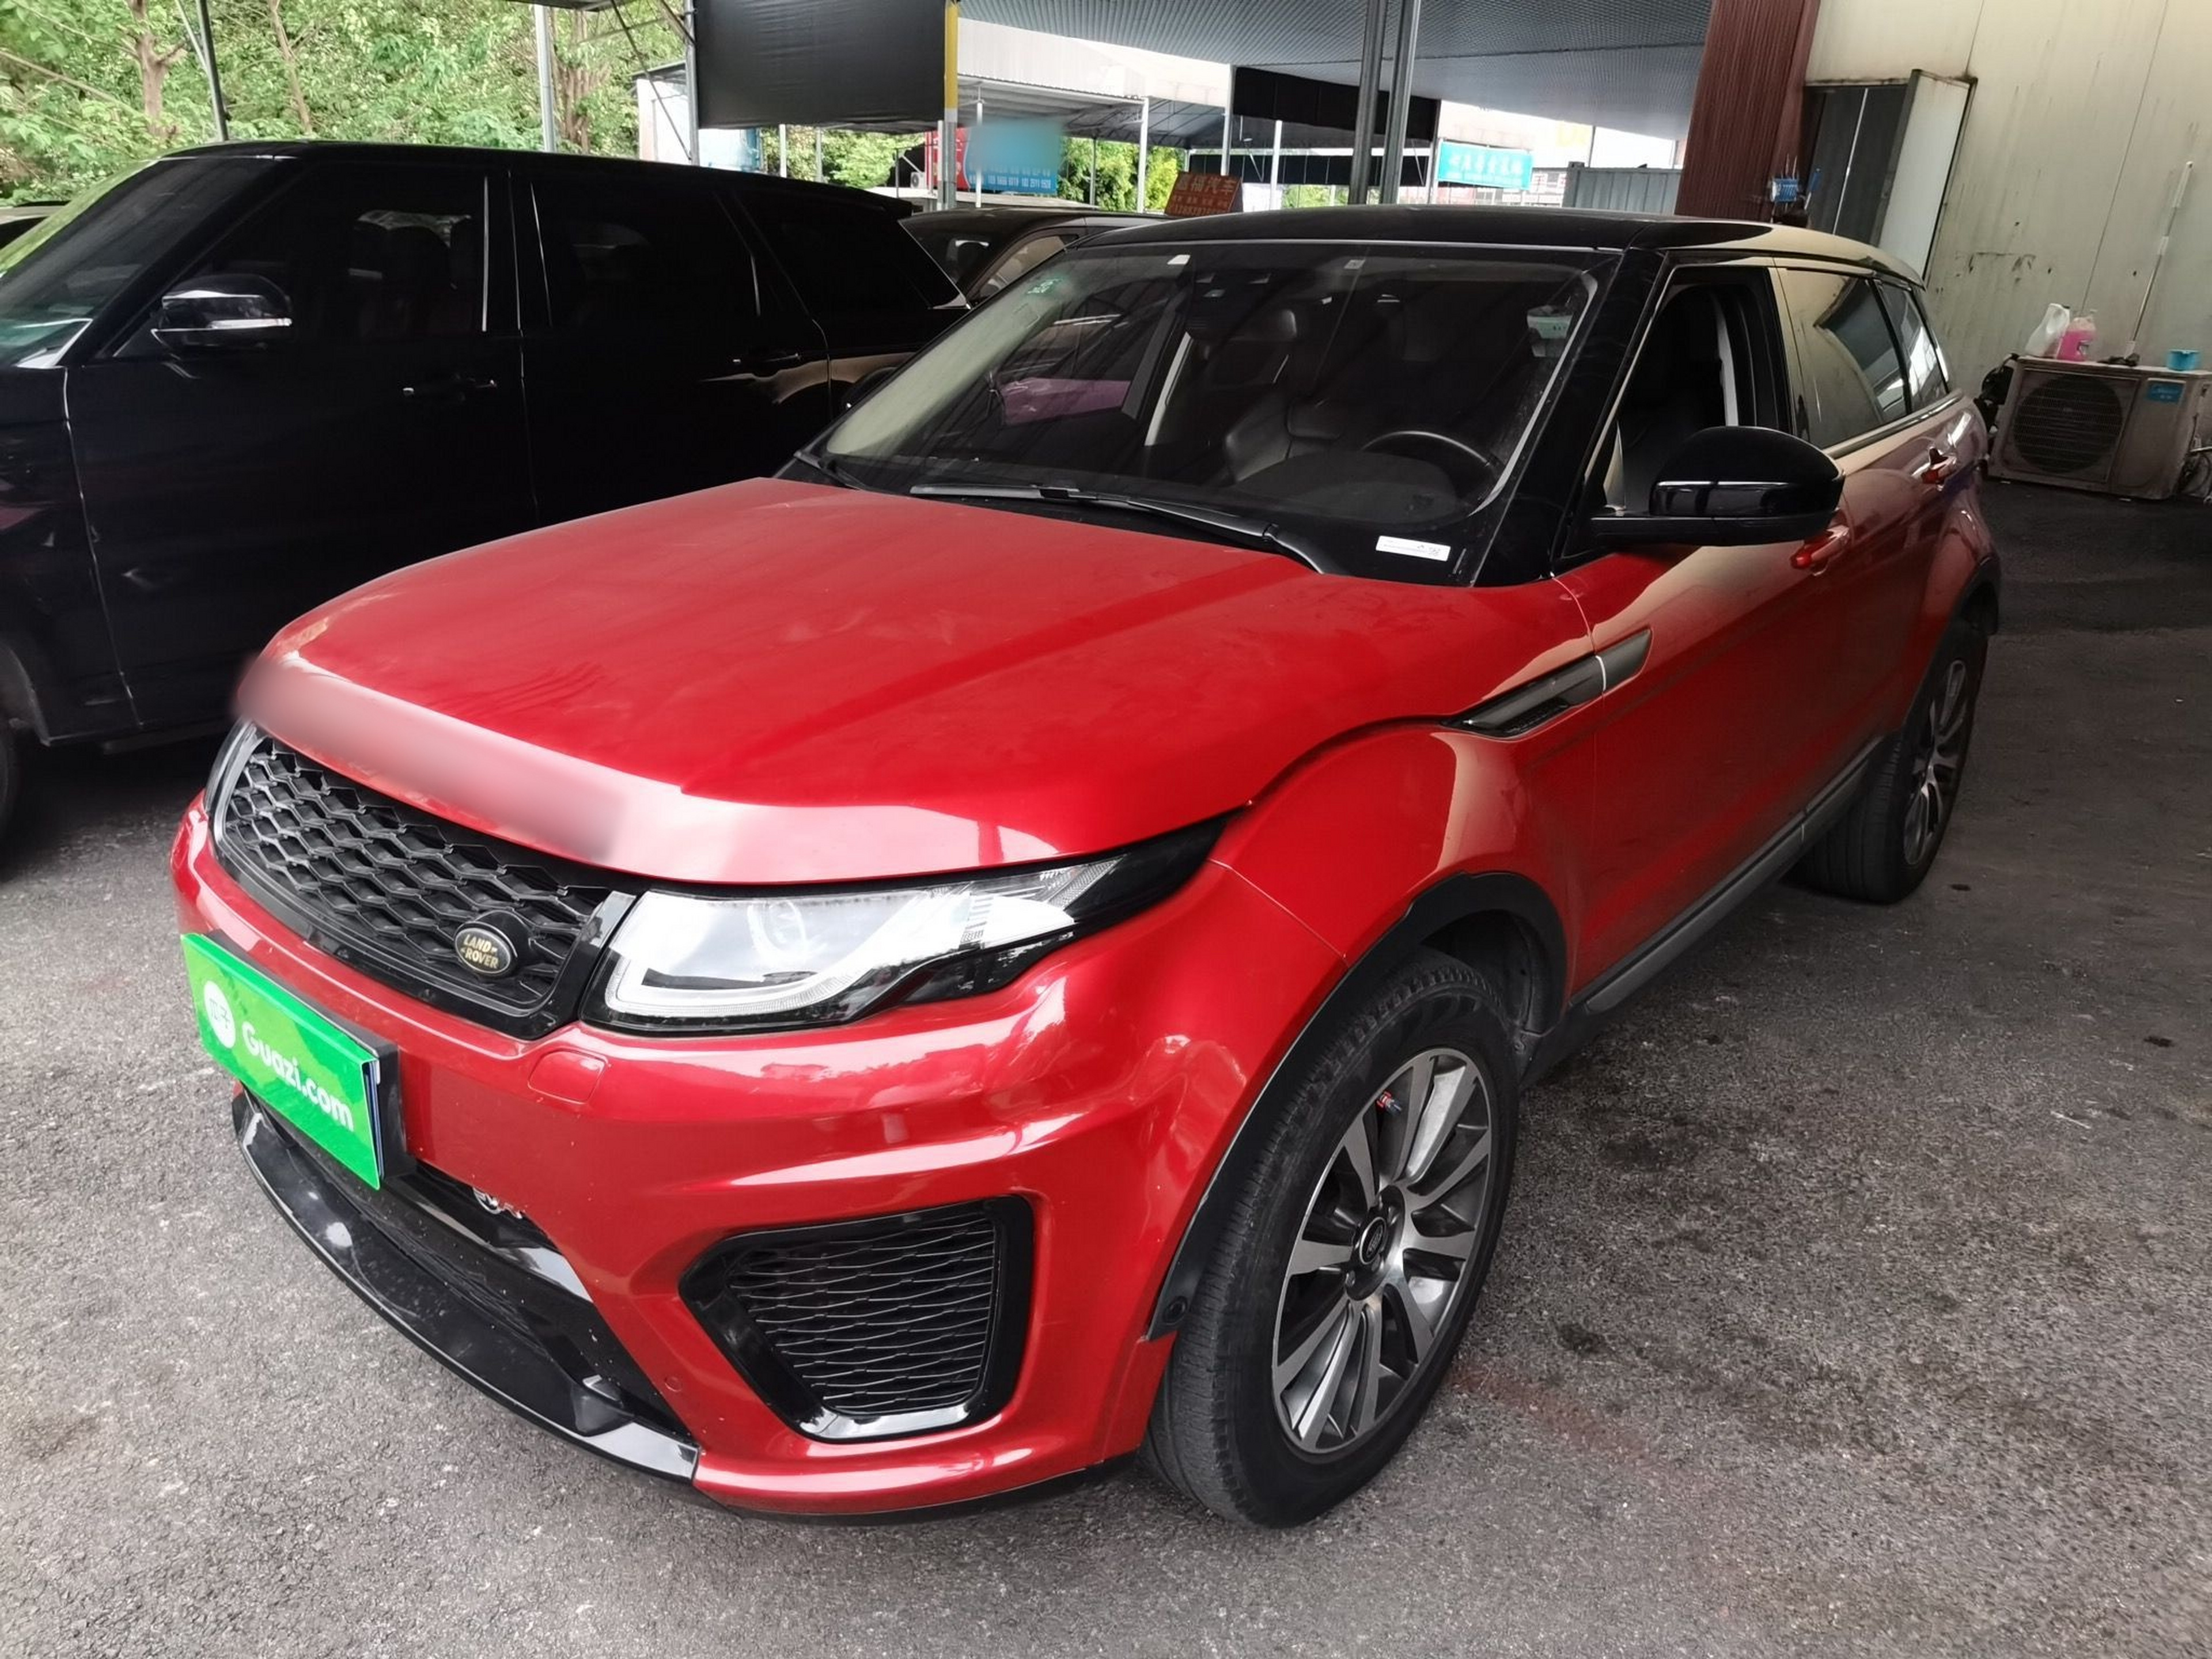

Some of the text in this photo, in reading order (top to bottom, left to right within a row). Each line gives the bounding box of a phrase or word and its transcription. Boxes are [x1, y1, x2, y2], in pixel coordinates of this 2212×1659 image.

[463, 933, 493, 953] LAND
[464, 946, 499, 969] ROVER
[241, 1021, 354, 1132] Guazi.com
